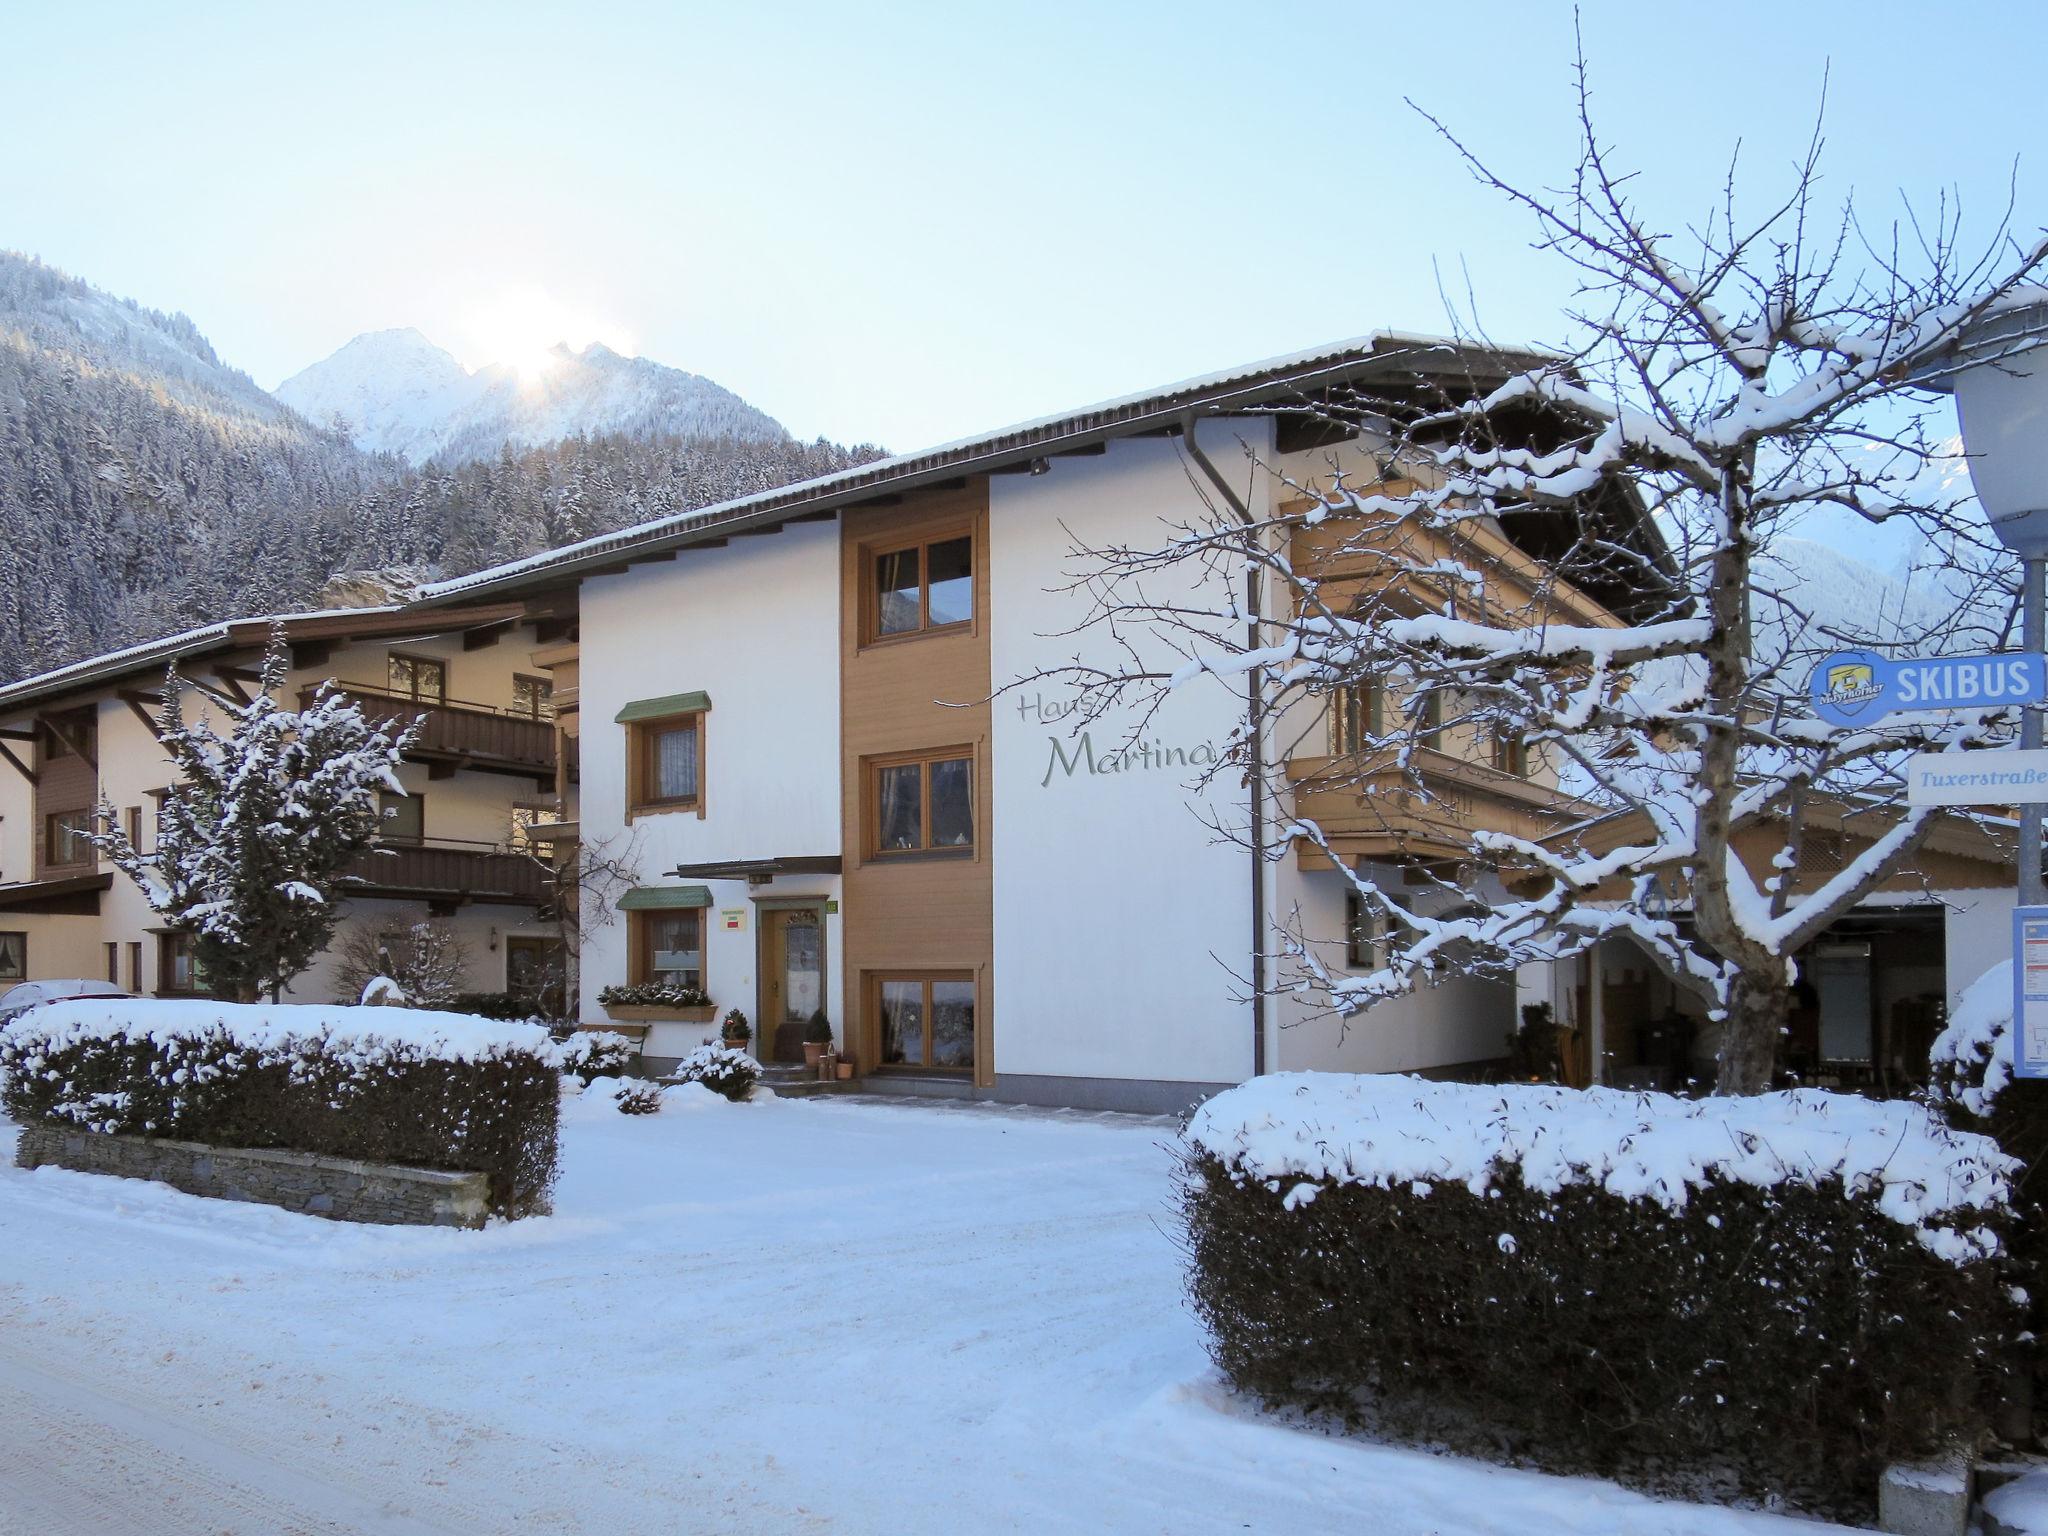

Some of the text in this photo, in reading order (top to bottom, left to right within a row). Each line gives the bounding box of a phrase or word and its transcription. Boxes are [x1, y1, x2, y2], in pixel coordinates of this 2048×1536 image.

[1897, 661, 2030, 702] SKIBUS
[1017, 692, 1094, 722] Haus
[1041, 732, 1216, 788] Martina
[1920, 768, 2048, 788] Tuxerstraße
